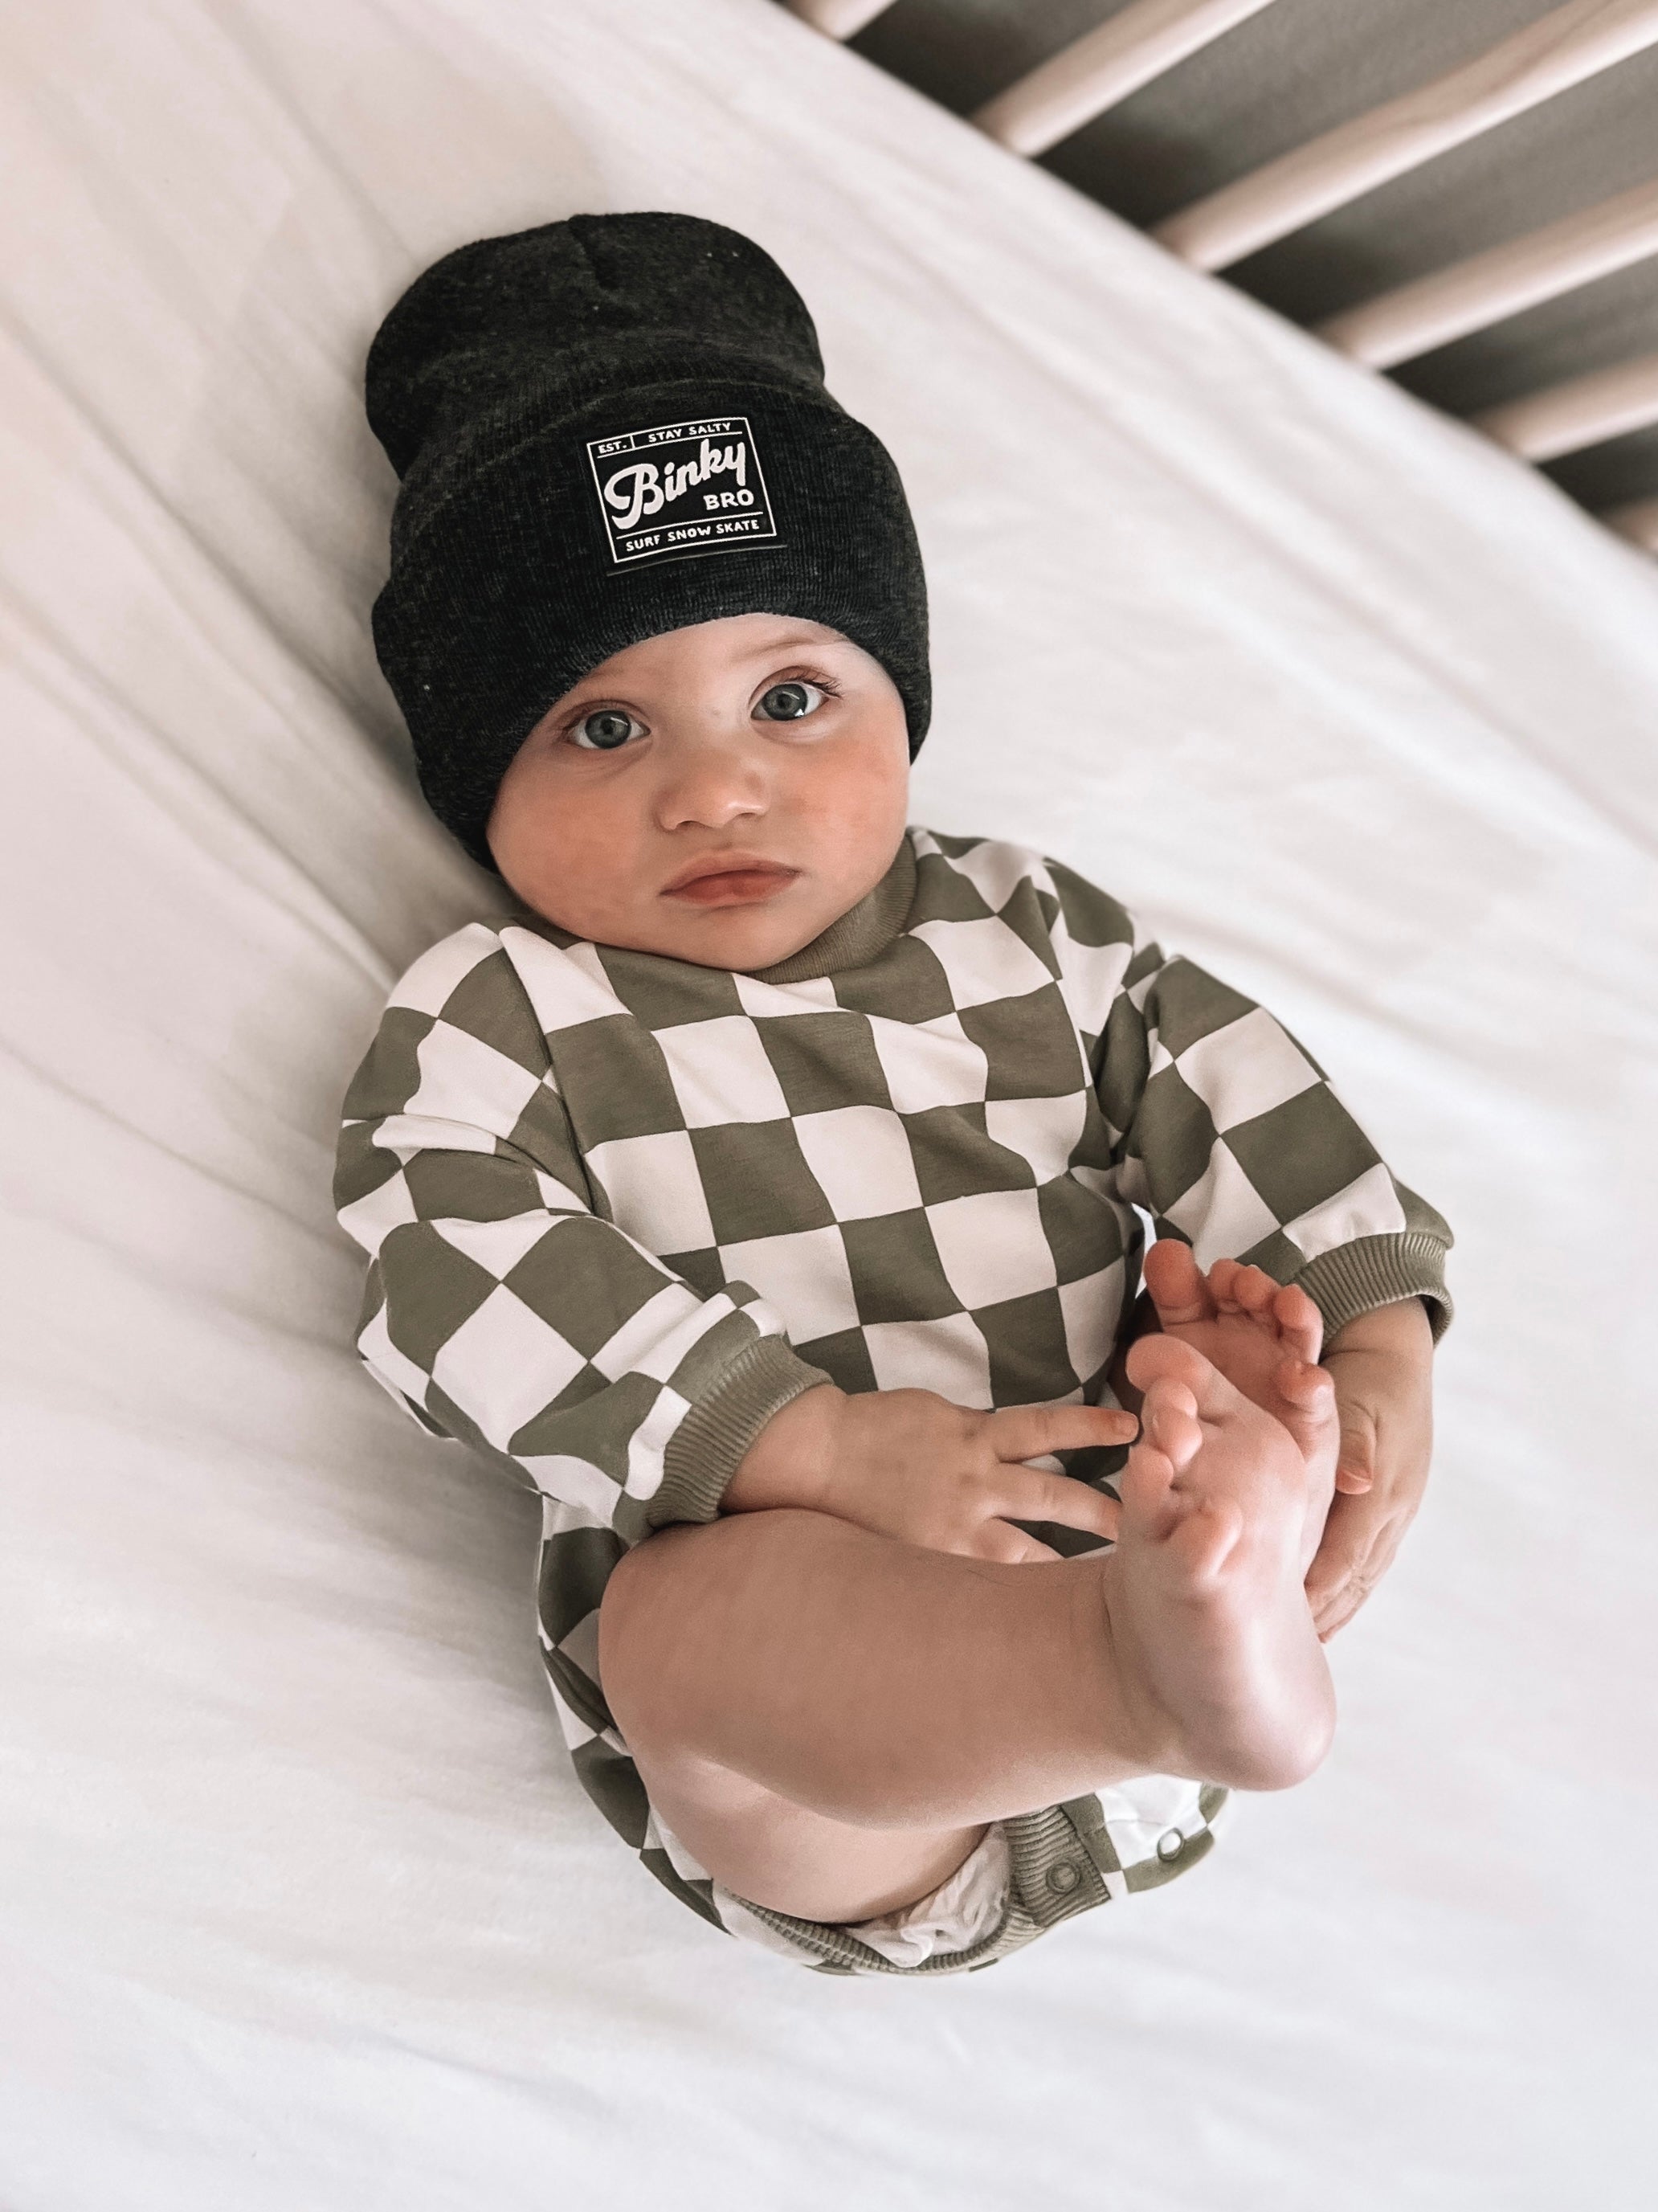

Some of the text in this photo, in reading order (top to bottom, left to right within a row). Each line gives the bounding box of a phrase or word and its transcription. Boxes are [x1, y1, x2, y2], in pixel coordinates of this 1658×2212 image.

[648, 422, 731, 443] STAY SALTY
[598, 440, 628, 454] EST.
[603, 438, 746, 530] Binky
[703, 489, 755, 511] BRO
[626, 519, 760, 552] SURF SNOW SKATE
